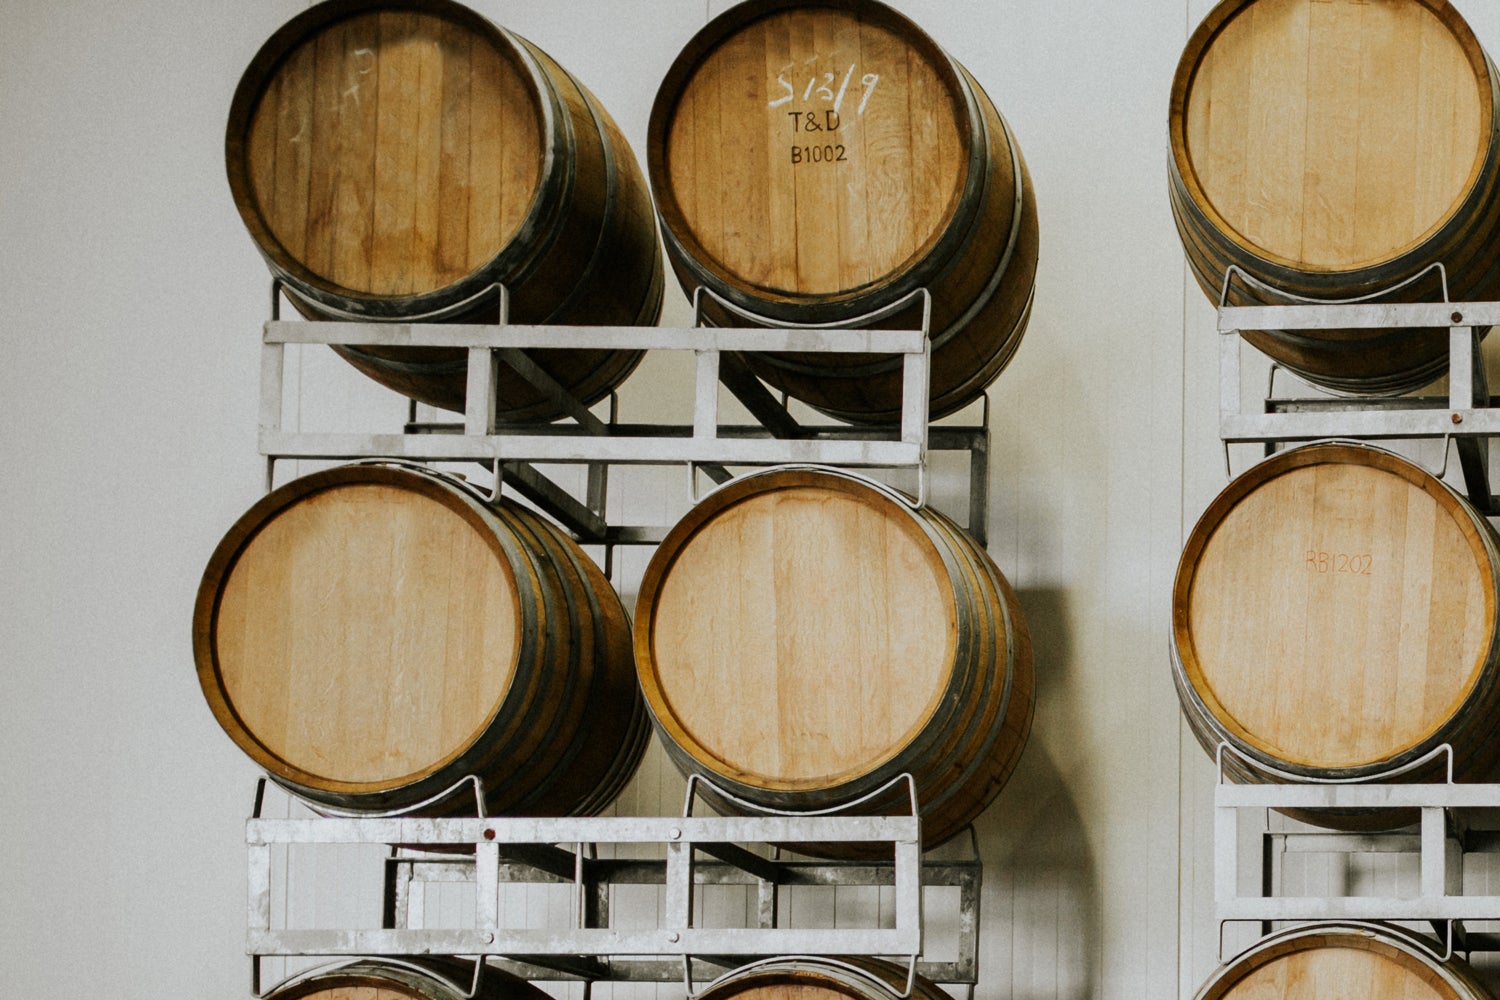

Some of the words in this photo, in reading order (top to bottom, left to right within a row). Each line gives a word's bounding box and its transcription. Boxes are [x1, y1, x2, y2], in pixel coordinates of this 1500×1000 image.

[788, 109, 840, 132] T&D
[791, 144, 848, 164] B1002
[1305, 550, 1373, 575] RB1202
